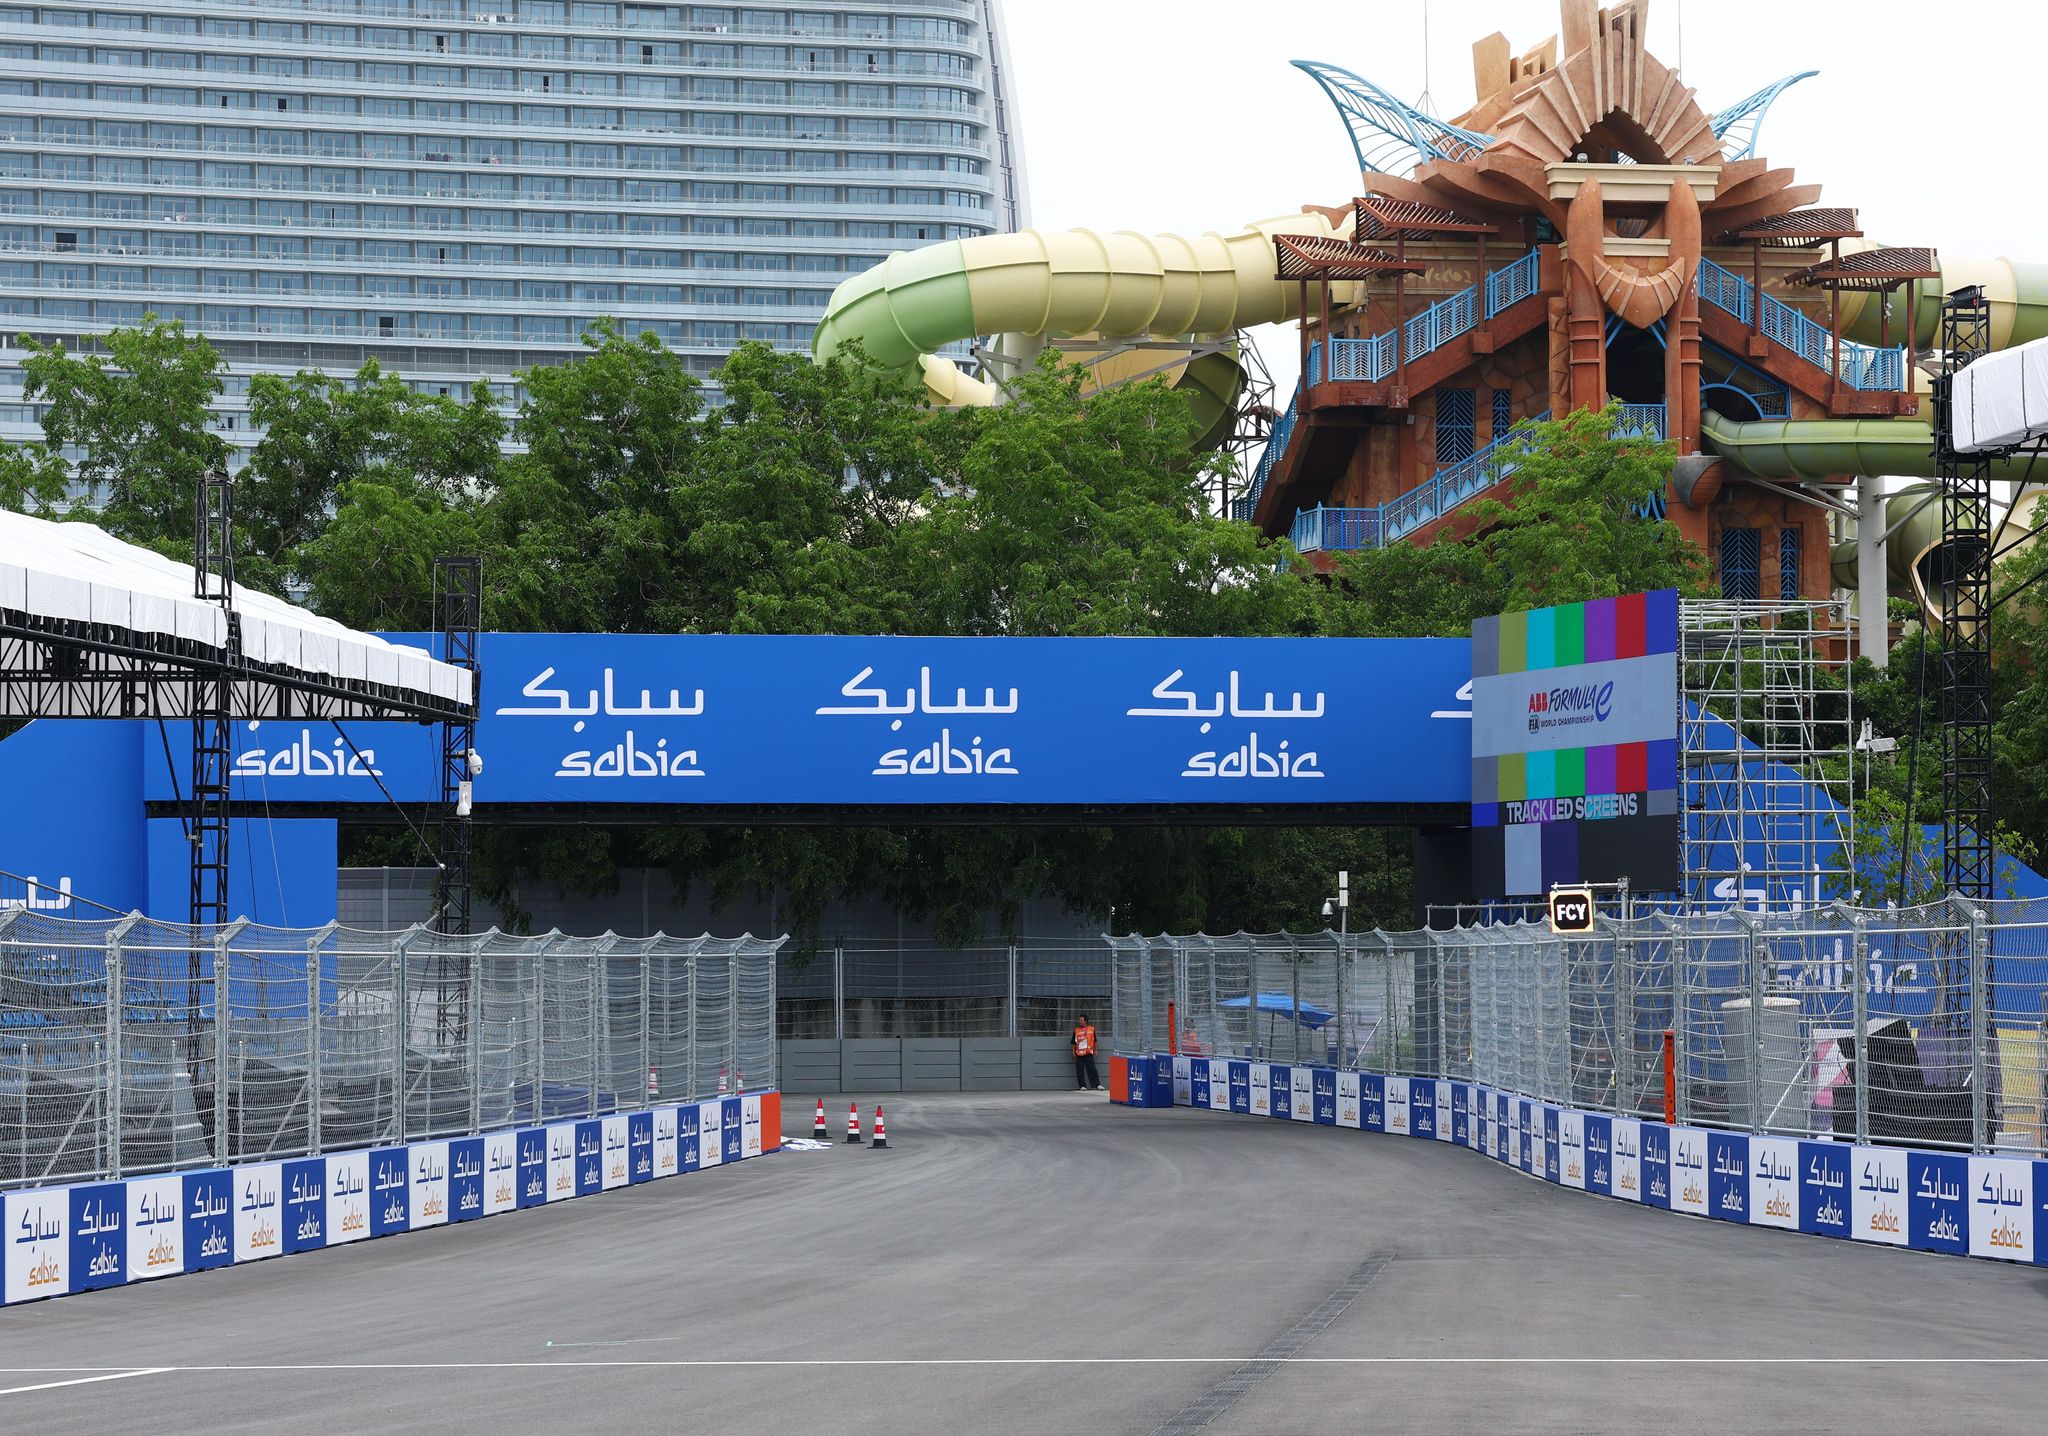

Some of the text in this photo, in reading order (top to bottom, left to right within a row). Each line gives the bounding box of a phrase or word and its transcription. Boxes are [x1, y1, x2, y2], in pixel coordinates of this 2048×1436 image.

[1529, 692, 1548, 713] ABB
[1548, 684, 1597, 713] FORMULA
[1541, 715, 1595, 728] WORLD CHAMPIONSHIP
[229, 729, 384, 776] sabic
[554, 730, 706, 777] sabic
[872, 728, 1019, 775] sabic
[1181, 732, 1325, 777] sabic
[1506, 793, 1638, 823] TRACK LED SCREENS
[1556, 903, 1587, 921] FCY
[423, 1190, 443, 1217] sabic
[460, 1184, 479, 1210] sabic
[1683, 1178, 1702, 1203] sabic
[1722, 1184, 1743, 1211] sabic
[1766, 1190, 1791, 1217] sabic
[298, 1210, 320, 1240] sabic
[341, 1203, 363, 1232] sabic
[384, 1196, 404, 1224] sabic
[1816, 1196, 1843, 1225] sabic
[1870, 1204, 1899, 1232] sabic
[1929, 1209, 1959, 1241] sabic
[201, 1225, 227, 1257] sabic
[250, 1217, 276, 1249] sabic
[1990, 1217, 2023, 1248] sabic
[89, 1242, 119, 1276] sabic
[147, 1233, 176, 1266] sabic
[28, 1251, 61, 1286] sabic
